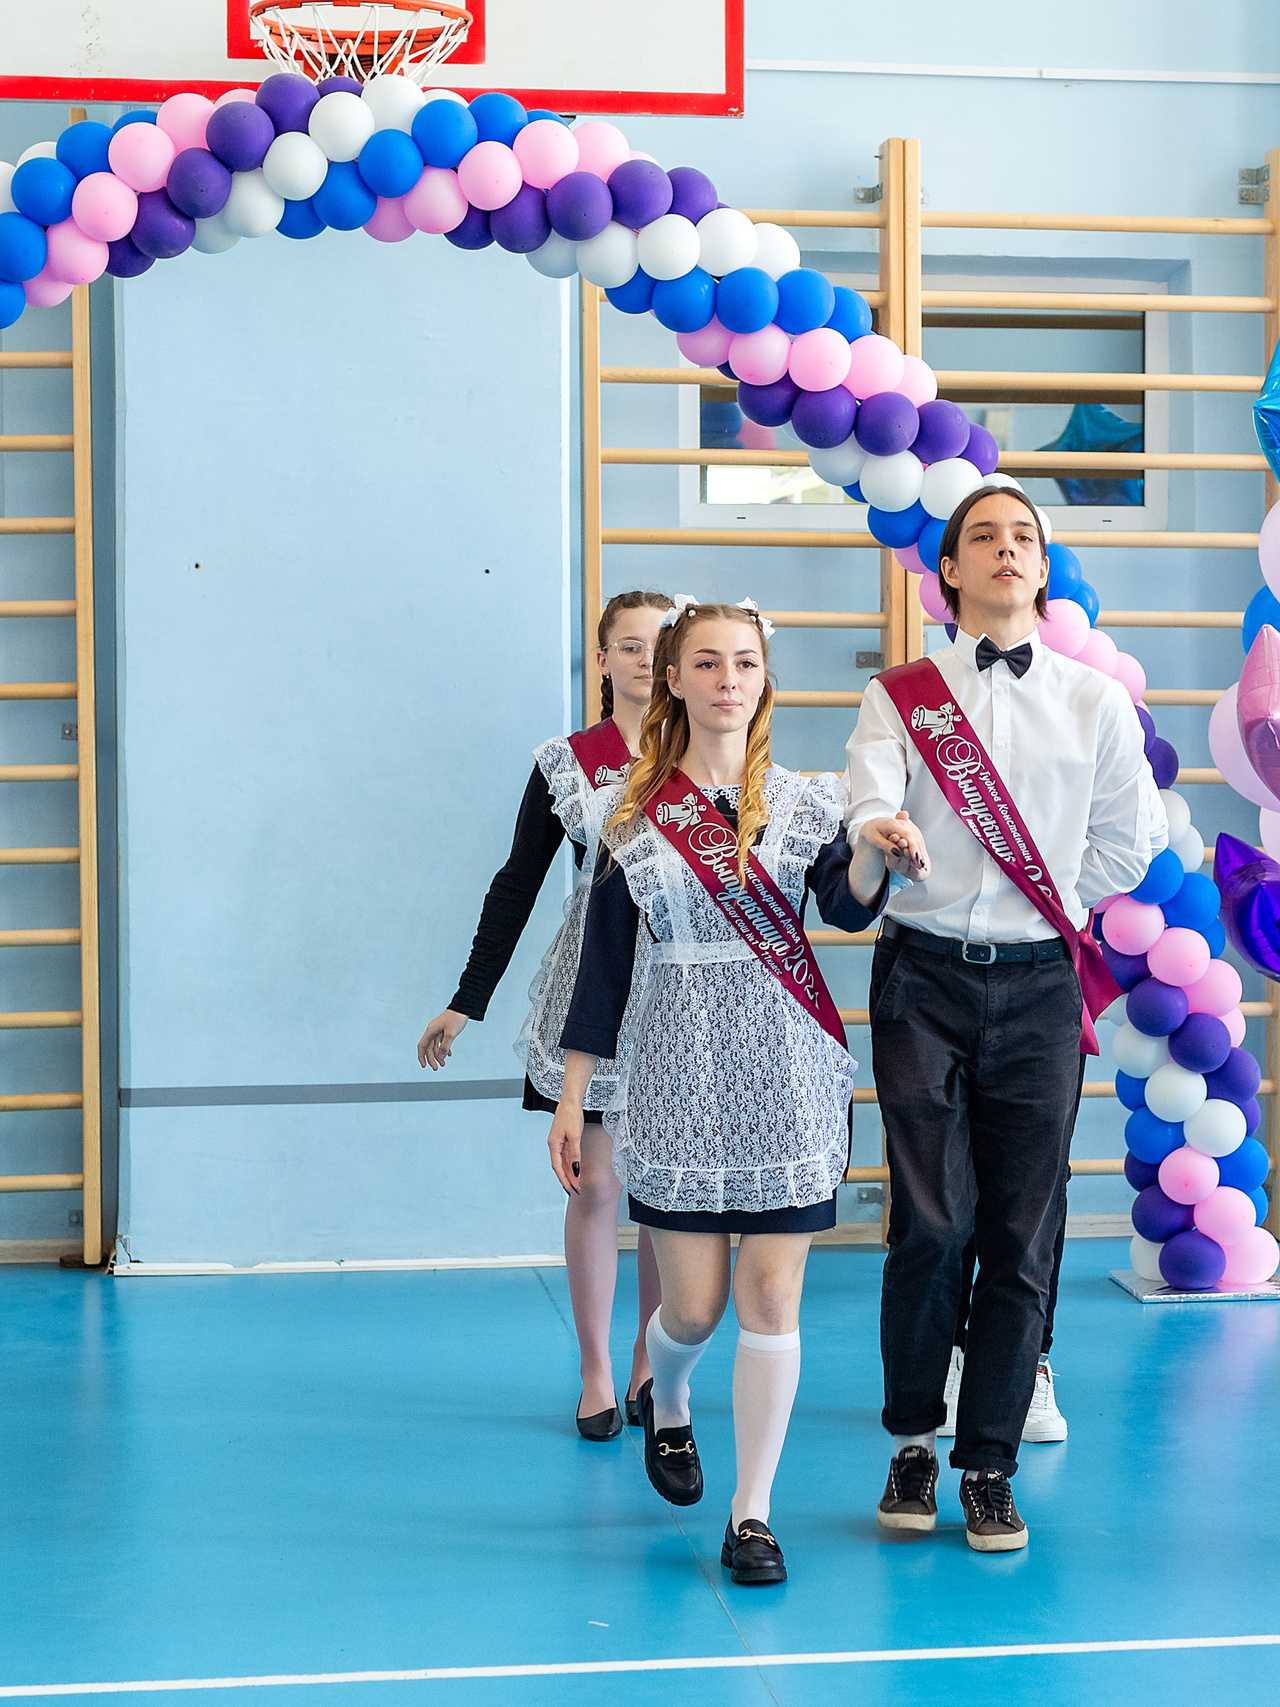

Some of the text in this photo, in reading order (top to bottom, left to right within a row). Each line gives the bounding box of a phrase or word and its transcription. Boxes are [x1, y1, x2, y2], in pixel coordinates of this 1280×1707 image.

[936, 735, 1016, 862] Выпускник
[966, 818, 981, 837] МБОУ
[979, 771, 1033, 862] Гудков Константин
[688, 822, 820, 1010] Выпускница 2021
[721, 901, 740, 919] МБОУ
[735, 918, 750, 933] СОШ
[735, 853, 801, 944] онастырная Дарья
